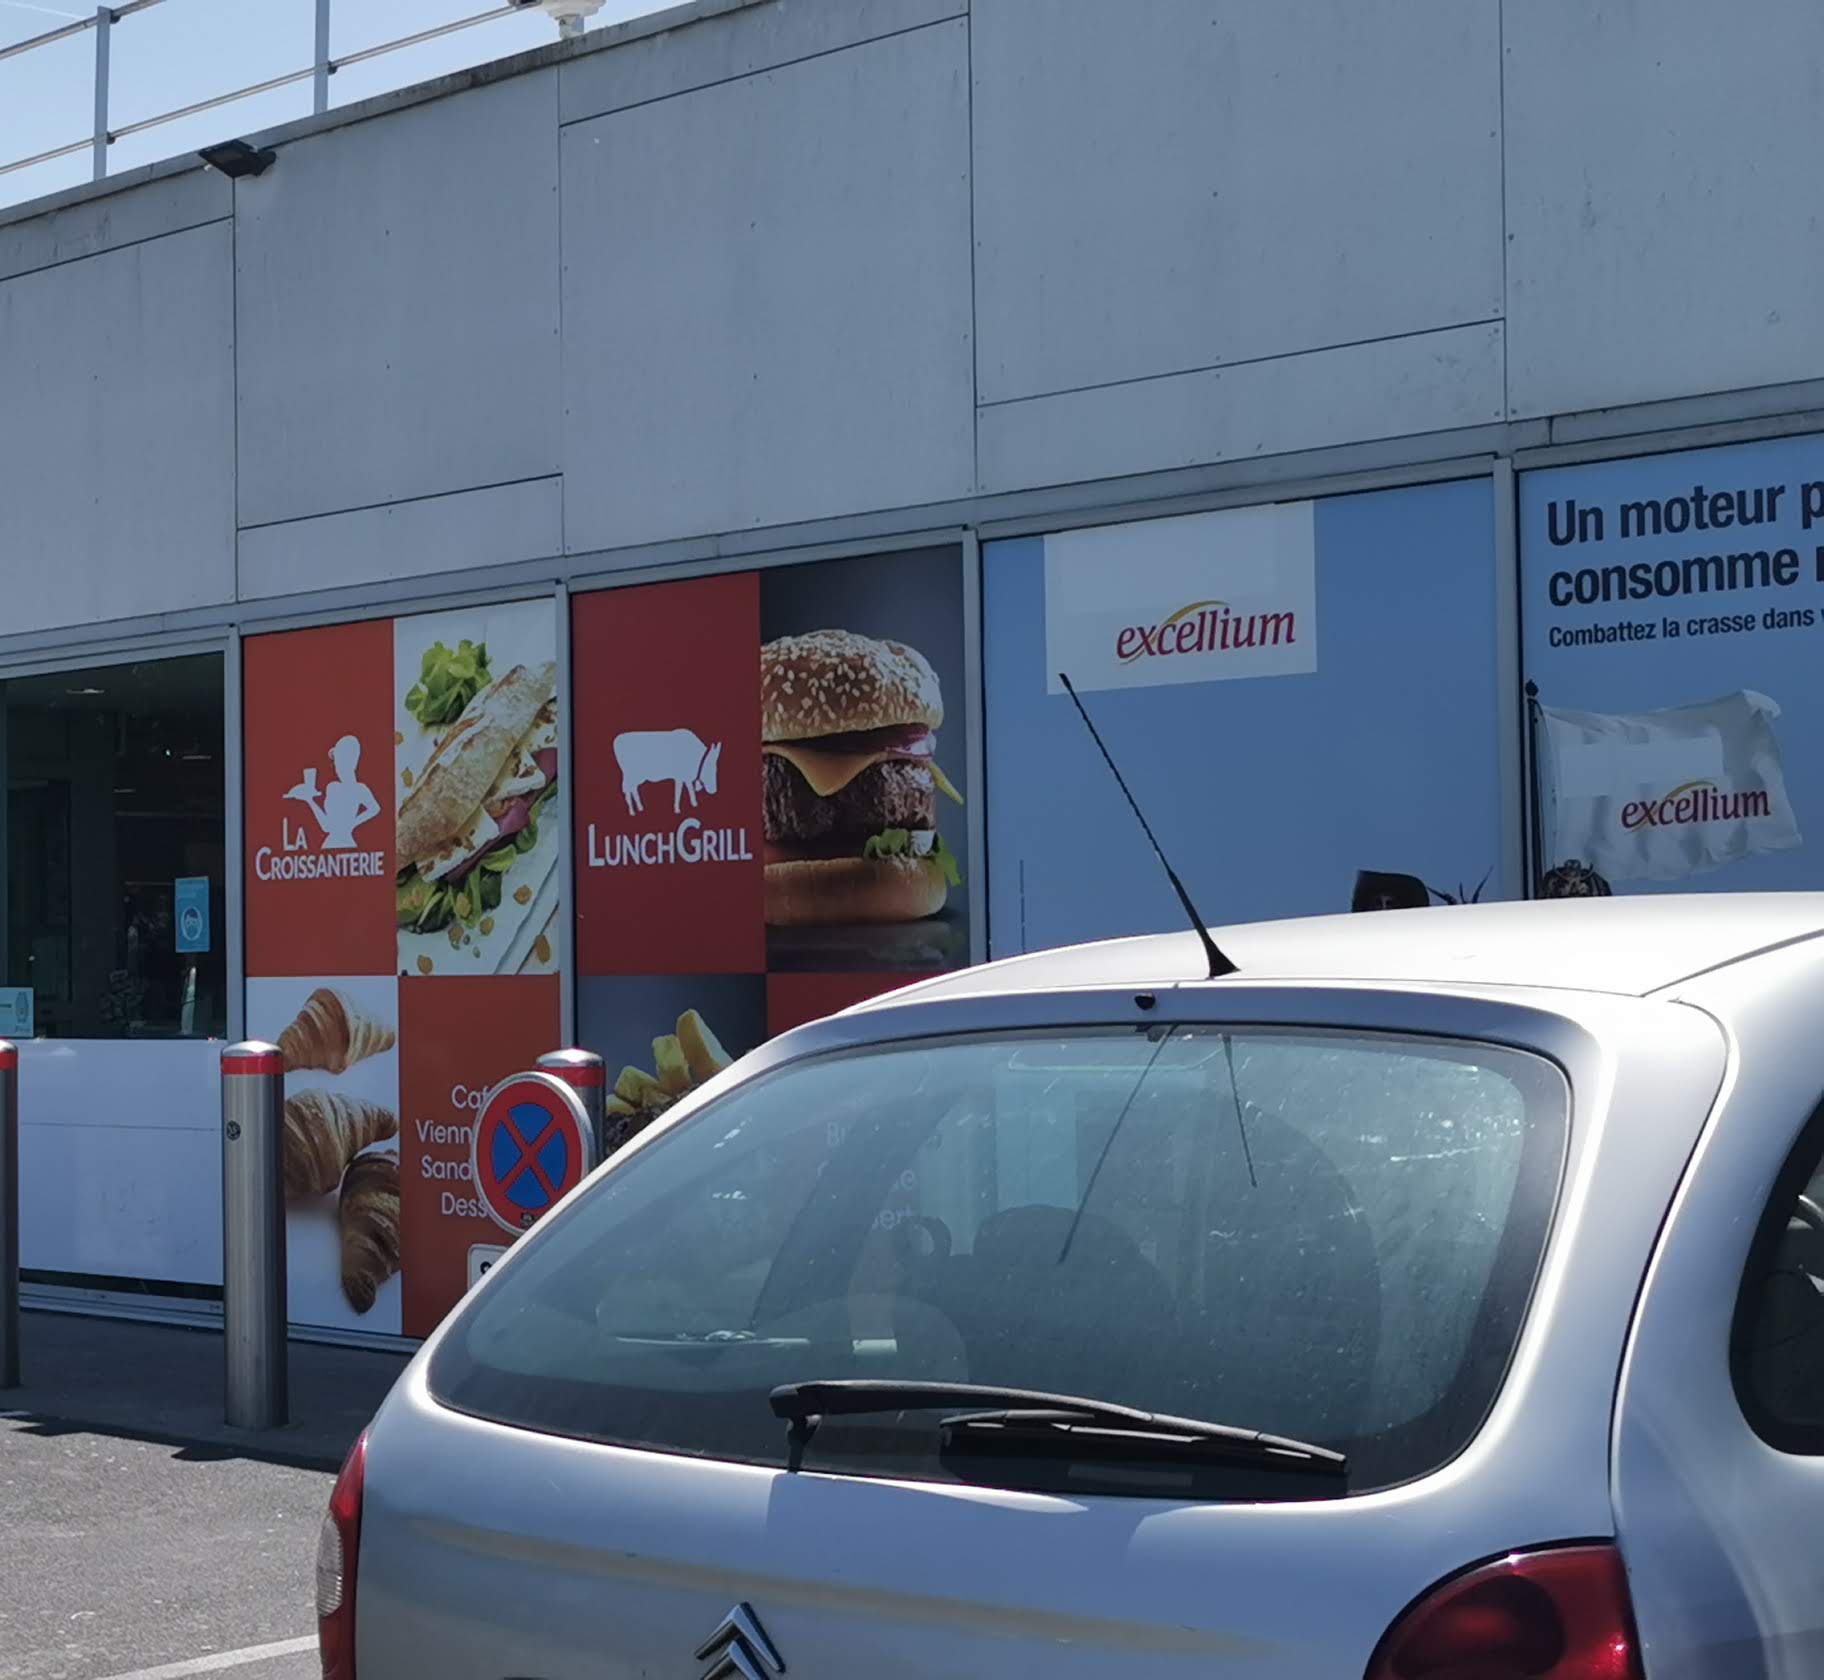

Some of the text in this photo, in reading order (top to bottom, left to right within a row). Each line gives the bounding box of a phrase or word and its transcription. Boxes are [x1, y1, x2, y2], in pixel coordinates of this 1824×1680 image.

[1547, 499, 1604, 546] Un
[1620, 485, 1786, 538] moteur
[1548, 547, 1800, 607] consomme
[1116, 605, 1297, 660] excellium
[1549, 620, 1657, 648] Combattez
[1662, 617, 1681, 639] la
[1686, 613, 1756, 637] crasse
[1762, 607, 1815, 631] dans
[1621, 786, 1771, 830] excellium
